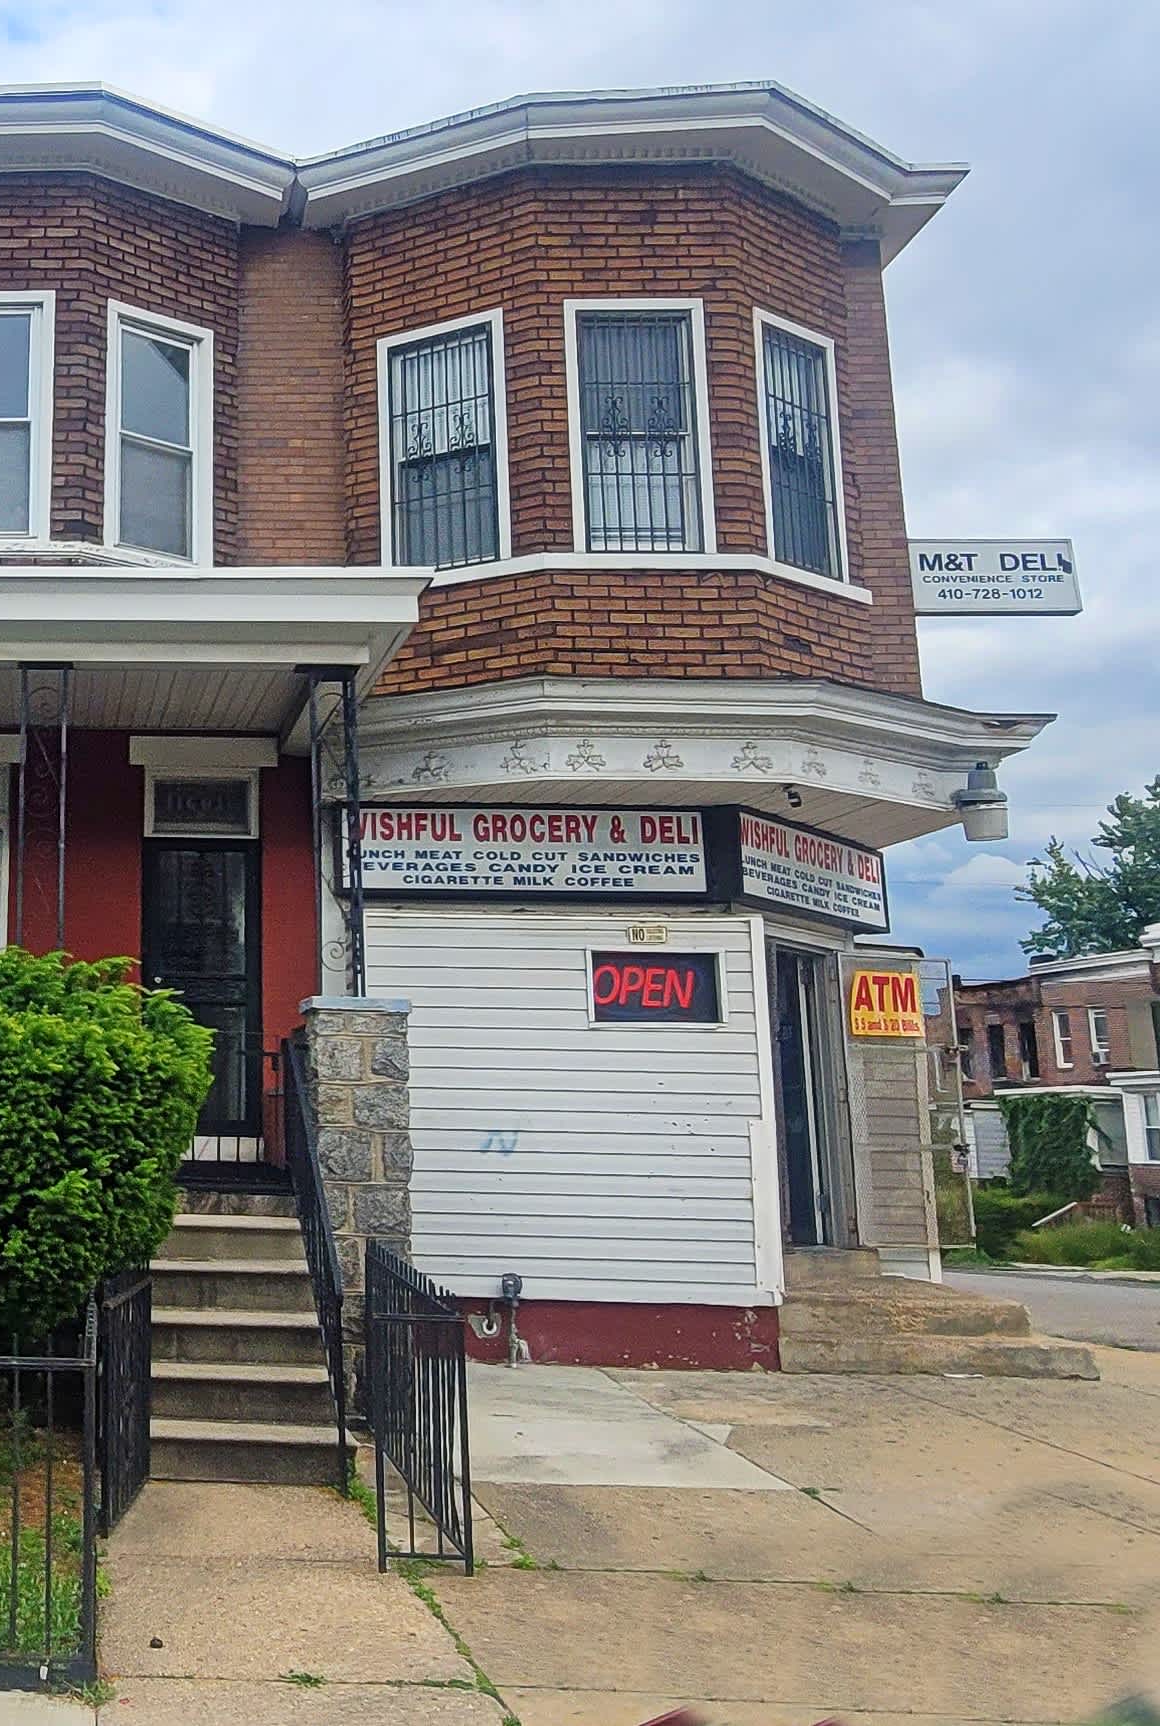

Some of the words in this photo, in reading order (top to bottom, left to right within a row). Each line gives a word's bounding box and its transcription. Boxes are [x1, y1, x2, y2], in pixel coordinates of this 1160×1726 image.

[919, 553, 978, 571] M&T
[1022, 575, 1064, 583] STORE
[938, 588, 1044, 599] 410-728-1012
[473, 814, 598, 843] GROCERY
[609, 815, 627, 844] &
[640, 816, 699, 844] DELI
[359, 850, 405, 859] UNCH
[414, 850, 463, 860] MEAT
[473, 851, 522, 860] COLD
[532, 852, 568, 861] CUT
[578, 852, 700, 863] SANDWICHES
[740, 817, 789, 858] WISHFUL
[794, 834, 843, 873] GROCERY
[847, 851, 854, 876] &
[858, 854, 880, 884] DELI
[363, 862, 477, 872] EVERAGES
[488, 863, 559, 873] CANDY
[571, 864, 607, 874] ICE
[618, 865, 694, 875] CREAM
[403, 875, 505, 885] CIGARETTE
[513, 876, 554, 886] MILK
[564, 877, 634, 887] COFFEE
[770, 862, 792, 876] MEAT
[794, 869, 815, 883] COLD
[818, 876, 832, 888] CUT
[836, 881, 881, 900] SANDWICHES
[766, 886, 811, 904] CIGARETTE
[813, 897, 830, 910] MILK
[833, 903, 860, 917] COFFEE
[801, 883, 830, 898] CANDY
[834, 891, 848, 903] ICE
[852, 897, 881, 911] CREAM
[631, 928, 645, 941] NO
[592, 963, 694, 1009] OPEN
[854, 975, 917, 1013] ATM
